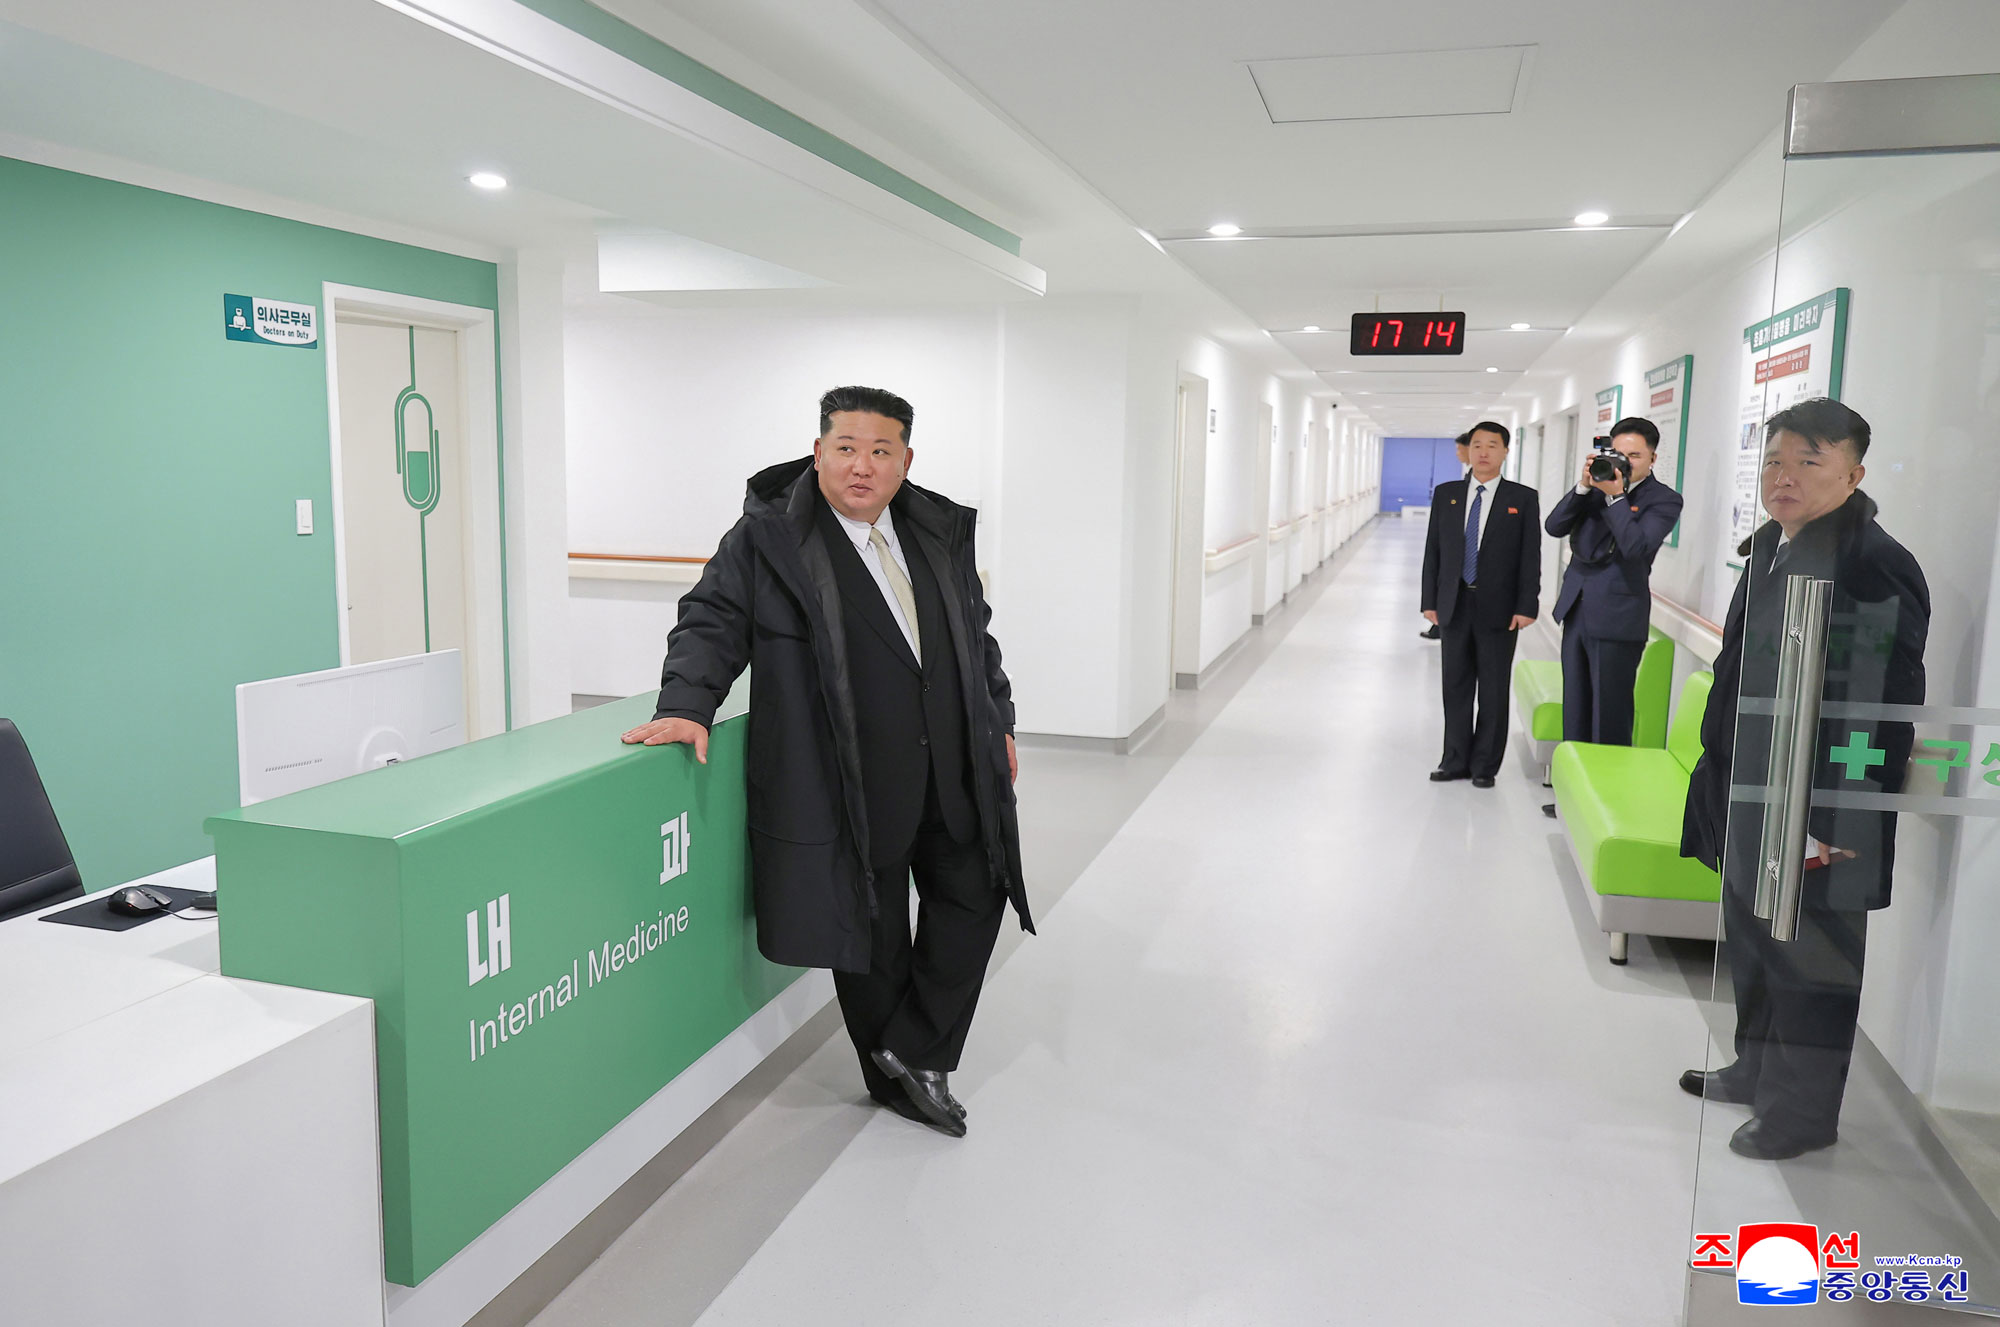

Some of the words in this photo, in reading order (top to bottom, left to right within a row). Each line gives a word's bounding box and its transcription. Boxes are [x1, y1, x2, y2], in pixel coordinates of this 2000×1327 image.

[257, 306, 311, 327] 의사근무실
[263, 325, 285, 337] Doctors
[288, 330, 295, 338] on
[297, 331, 309, 340] Duty
[1371, 320, 1404, 348] 17
[1423, 321, 1456, 348] 14
[466, 893, 512, 987] 내
[659, 811, 691, 886] 과
[469, 958, 579, 1062] Internal
[588, 905, 690, 989] Medicine
